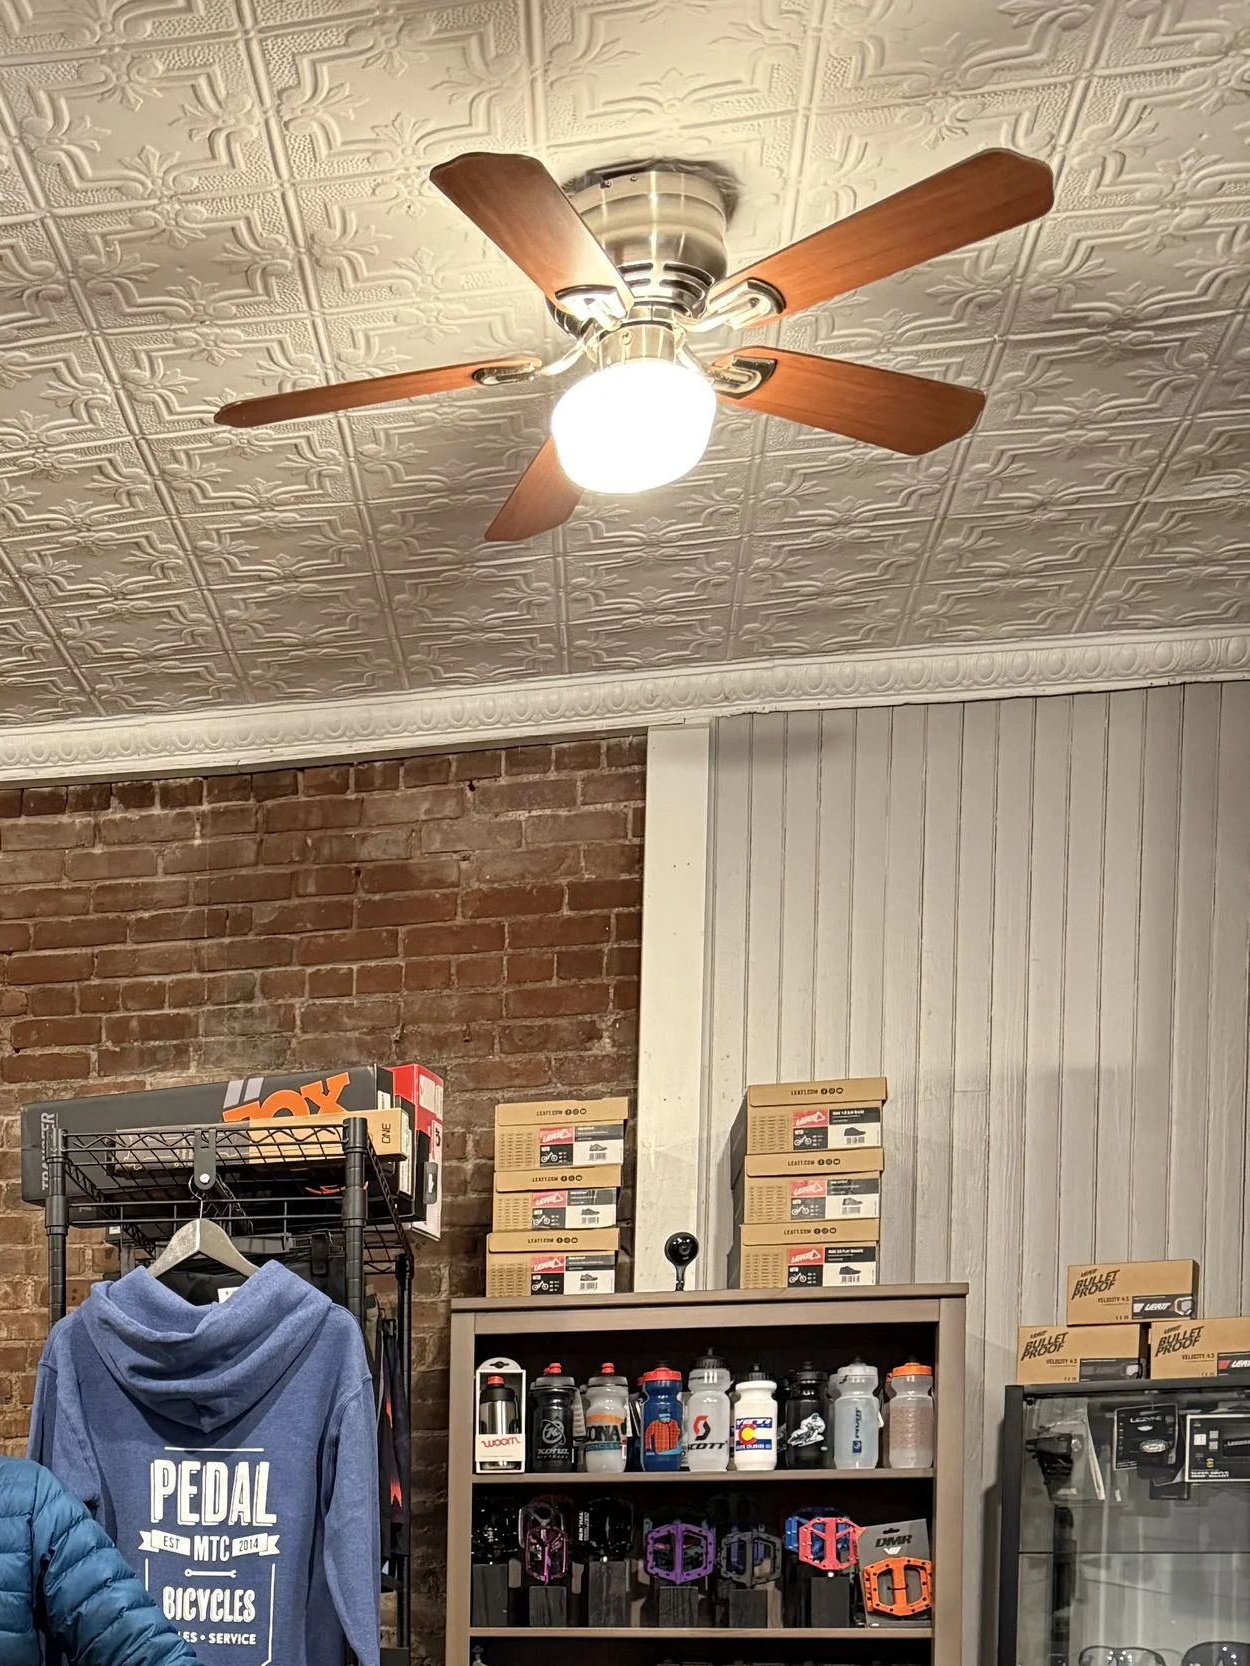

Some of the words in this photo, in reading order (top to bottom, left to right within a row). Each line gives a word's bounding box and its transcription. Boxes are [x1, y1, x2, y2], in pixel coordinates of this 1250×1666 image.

[381, 1123, 392, 1144] ONE
[1076, 1270, 1120, 1289] BULLET
[1071, 1280, 1115, 1300] PROOF
[1025, 1332, 1069, 1351] BULLET
[1159, 1326, 1204, 1346] BULLET
[1021, 1343, 1064, 1360] PROOF
[1155, 1337, 1200, 1357] PROOF
[150, 1459, 277, 1526] PEDAL
[163, 1535, 180, 1550] EST
[193, 1535, 230, 1561] MTC
[239, 1538, 259, 1552] 2014
[875, 1535, 913, 1548] DMR
[162, 1586, 256, 1623] BICYCLES
[208, 1632, 256, 1645] SERVICE
